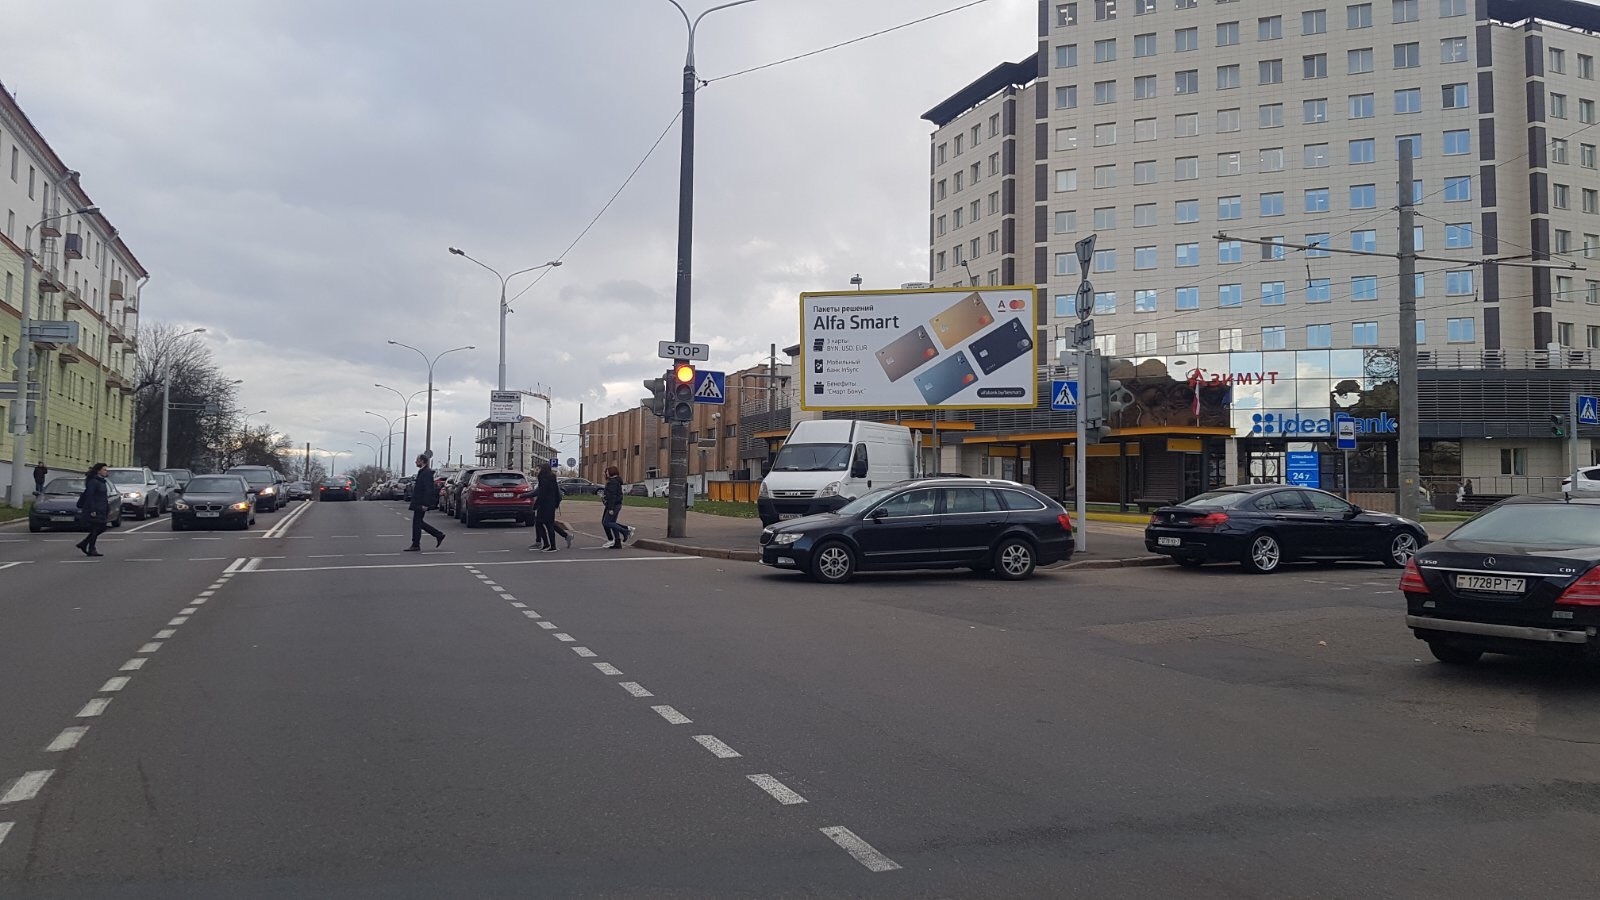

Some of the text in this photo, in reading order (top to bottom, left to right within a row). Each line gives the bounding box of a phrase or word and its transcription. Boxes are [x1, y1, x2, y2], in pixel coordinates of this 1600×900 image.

[813, 304, 874, 314] Пакеты решений
[813, 315, 900, 330] Alfa Smart
[667, 345, 700, 357] STOP
[1278, 413, 1332, 433] Idea
